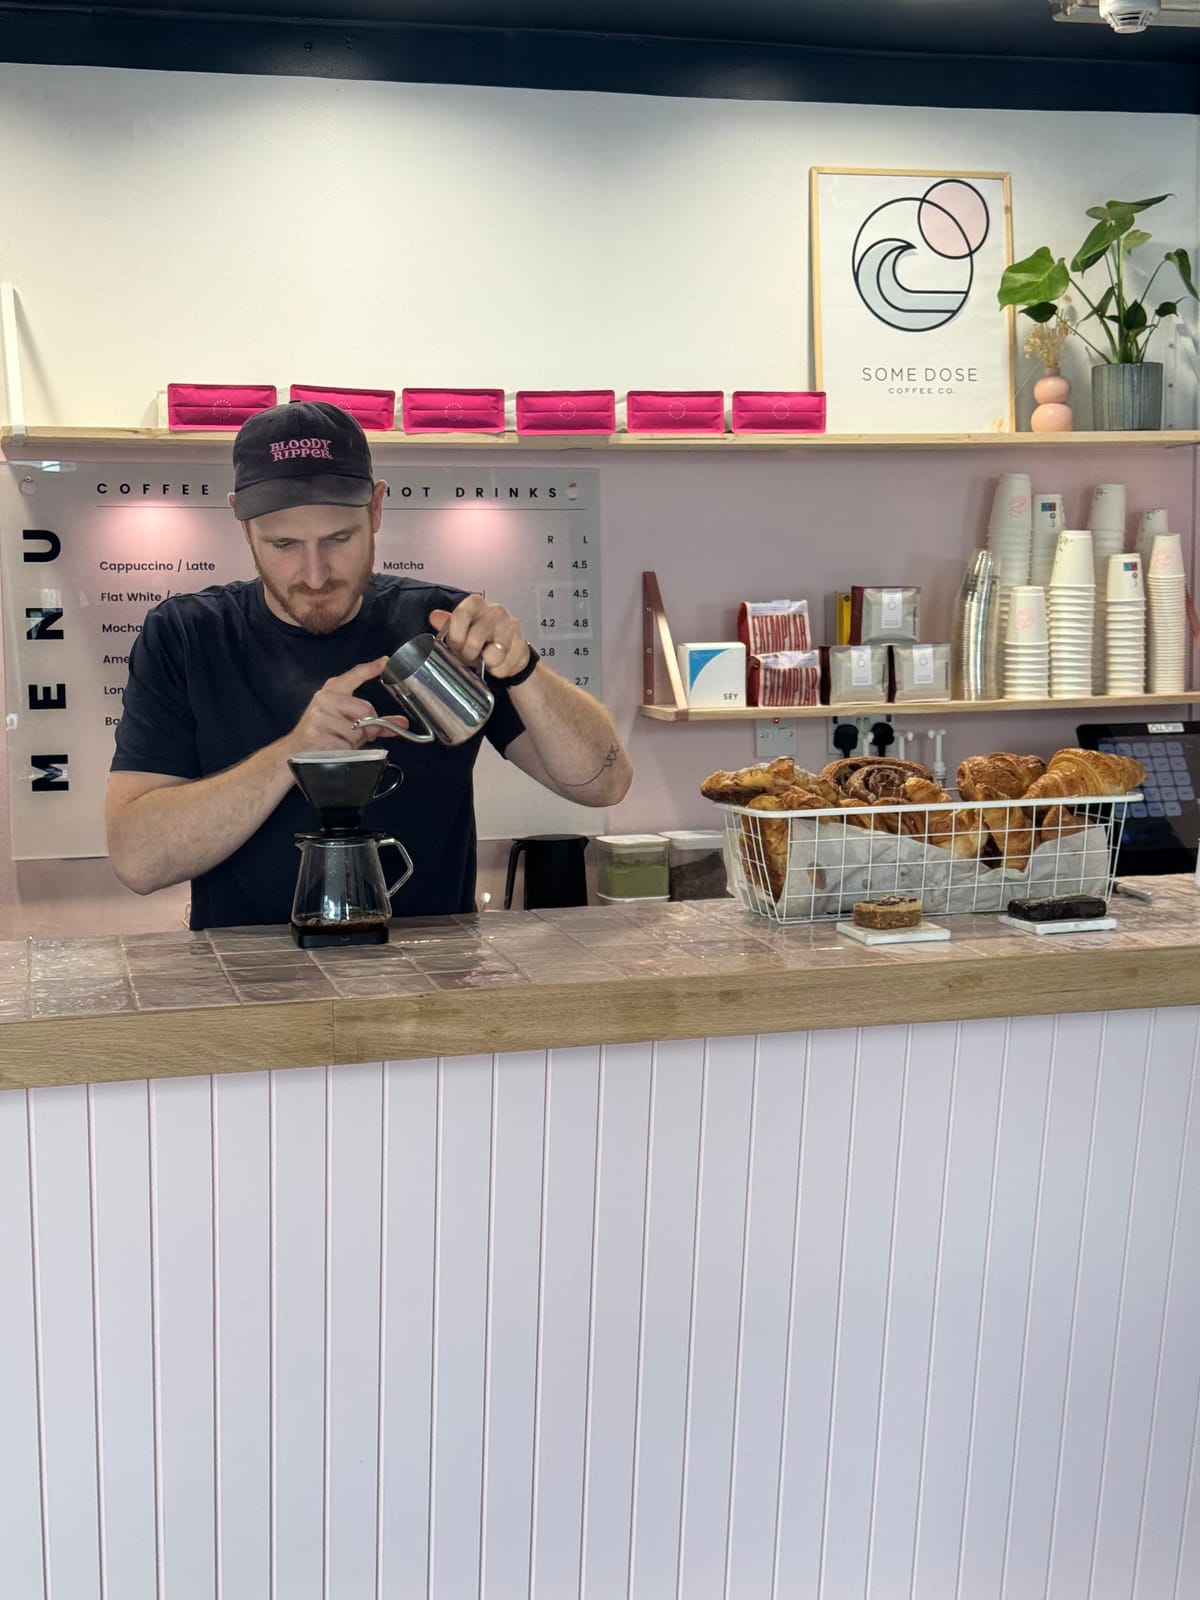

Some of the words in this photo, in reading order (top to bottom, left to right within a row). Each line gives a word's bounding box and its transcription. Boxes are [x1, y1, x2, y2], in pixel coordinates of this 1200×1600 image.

[862, 367, 917, 381] SOME
[925, 367, 978, 381] DOSE
[269, 438, 332, 453] BLOODY
[96, 483, 209, 495] COFFEE
[455, 487, 557, 498] DRINKS
[547, 535, 554, 544] R
[583, 535, 588, 544] L
[99, 561, 174, 573] Cappuccino
[177, 559, 182, 572] /
[186, 561, 215, 571] Latte
[383, 561, 424, 570] Matcha
[547, 560, 554, 569] 4
[572, 560, 588, 569] 4.5
[101, 592, 123, 602] Flat
[127, 592, 161, 602] White
[547, 590, 554, 598] 4
[573, 590, 588, 598] 4.5
[541, 619, 555, 628] 4.2
[573, 619, 588, 628] 4.8
[540, 648, 555, 657] 3.8
[573, 648, 589, 656] 4.5
[22, 529, 70, 792] MENU
[575, 677, 589, 686] 2.7
